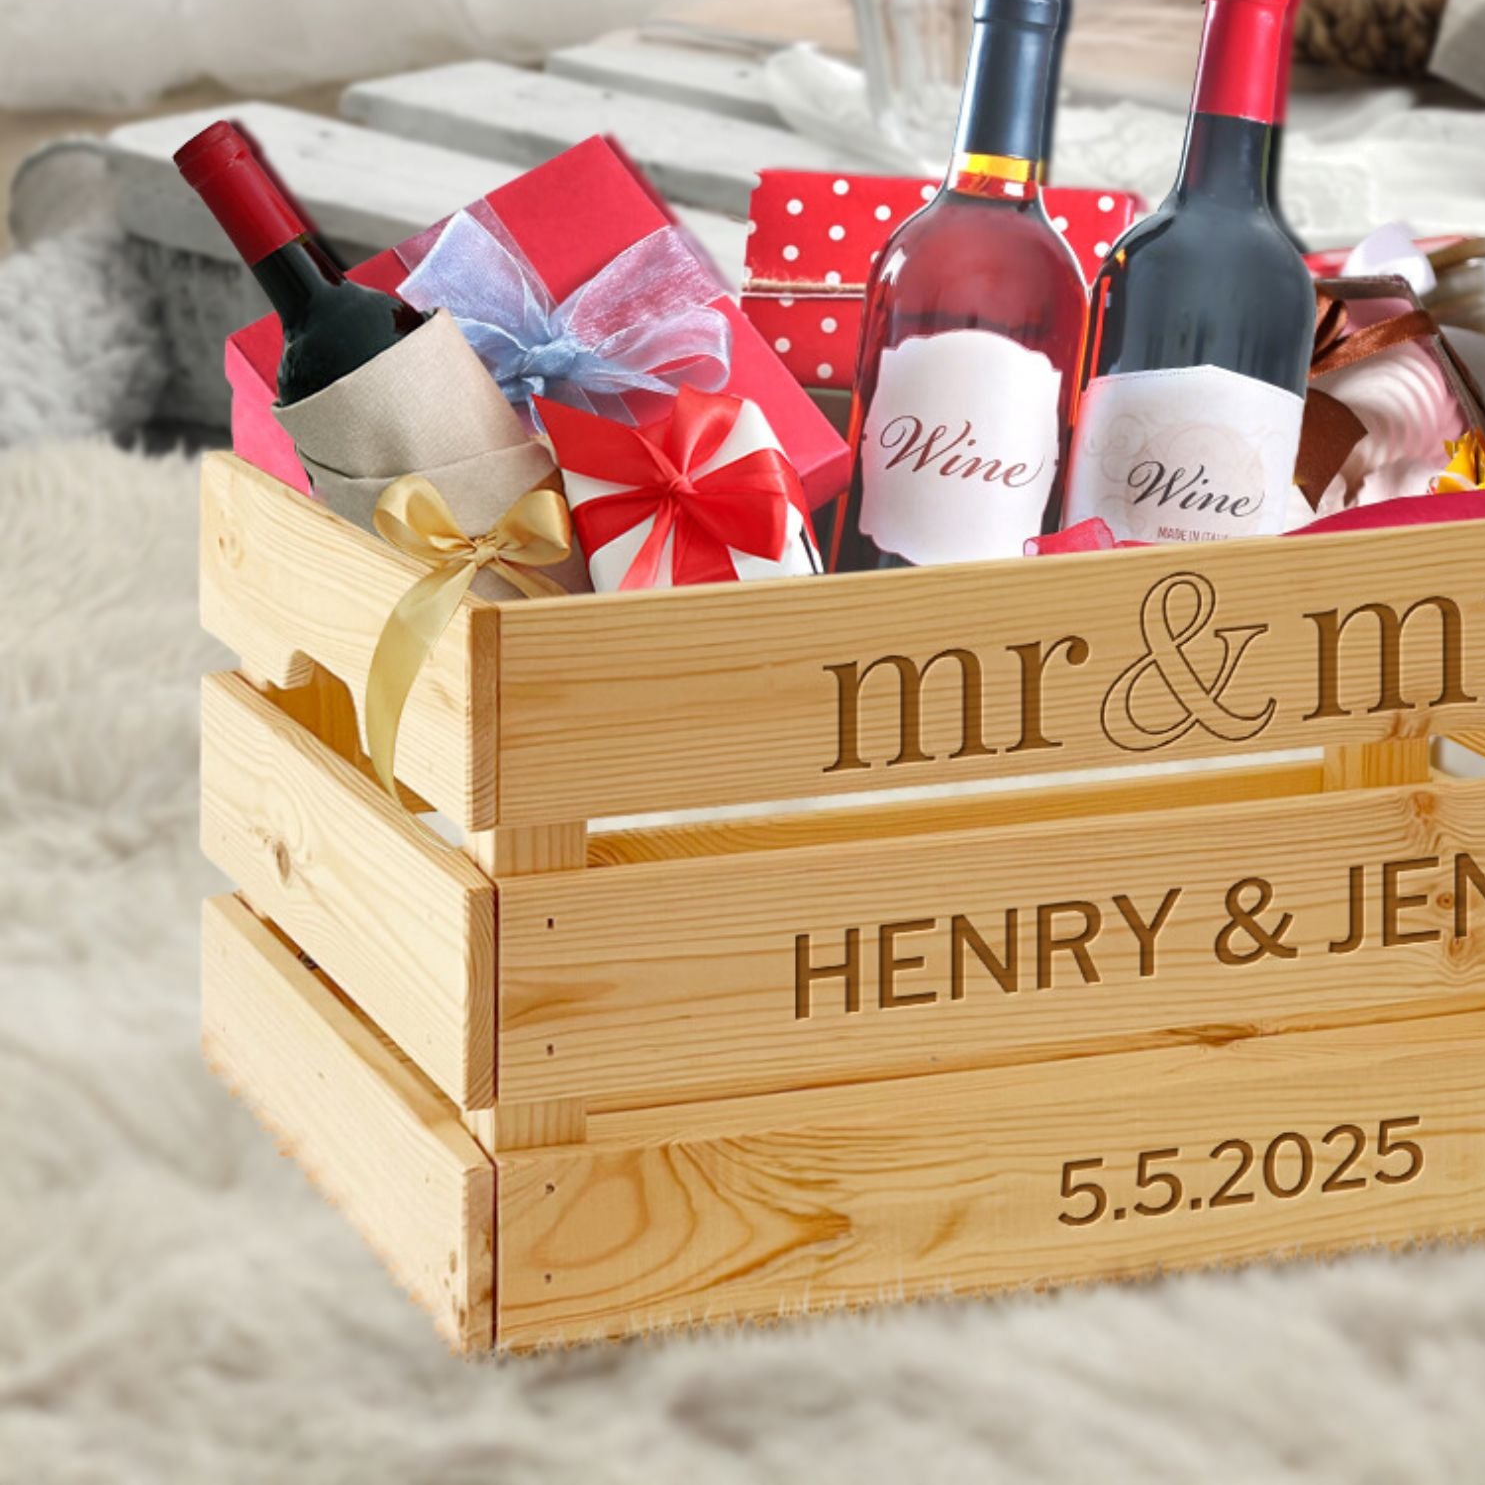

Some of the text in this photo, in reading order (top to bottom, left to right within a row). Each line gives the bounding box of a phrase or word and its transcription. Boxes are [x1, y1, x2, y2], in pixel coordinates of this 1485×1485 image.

[879, 414, 1046, 488] Wine
[1126, 459, 1265, 518] Wine
[821, 633, 1091, 774] mr
[1099, 570, 1278, 753] &
[794, 887, 1183, 1021] HENRY
[1213, 876, 1299, 967] &
[1056, 1115, 1427, 1227] 5.5.2025
